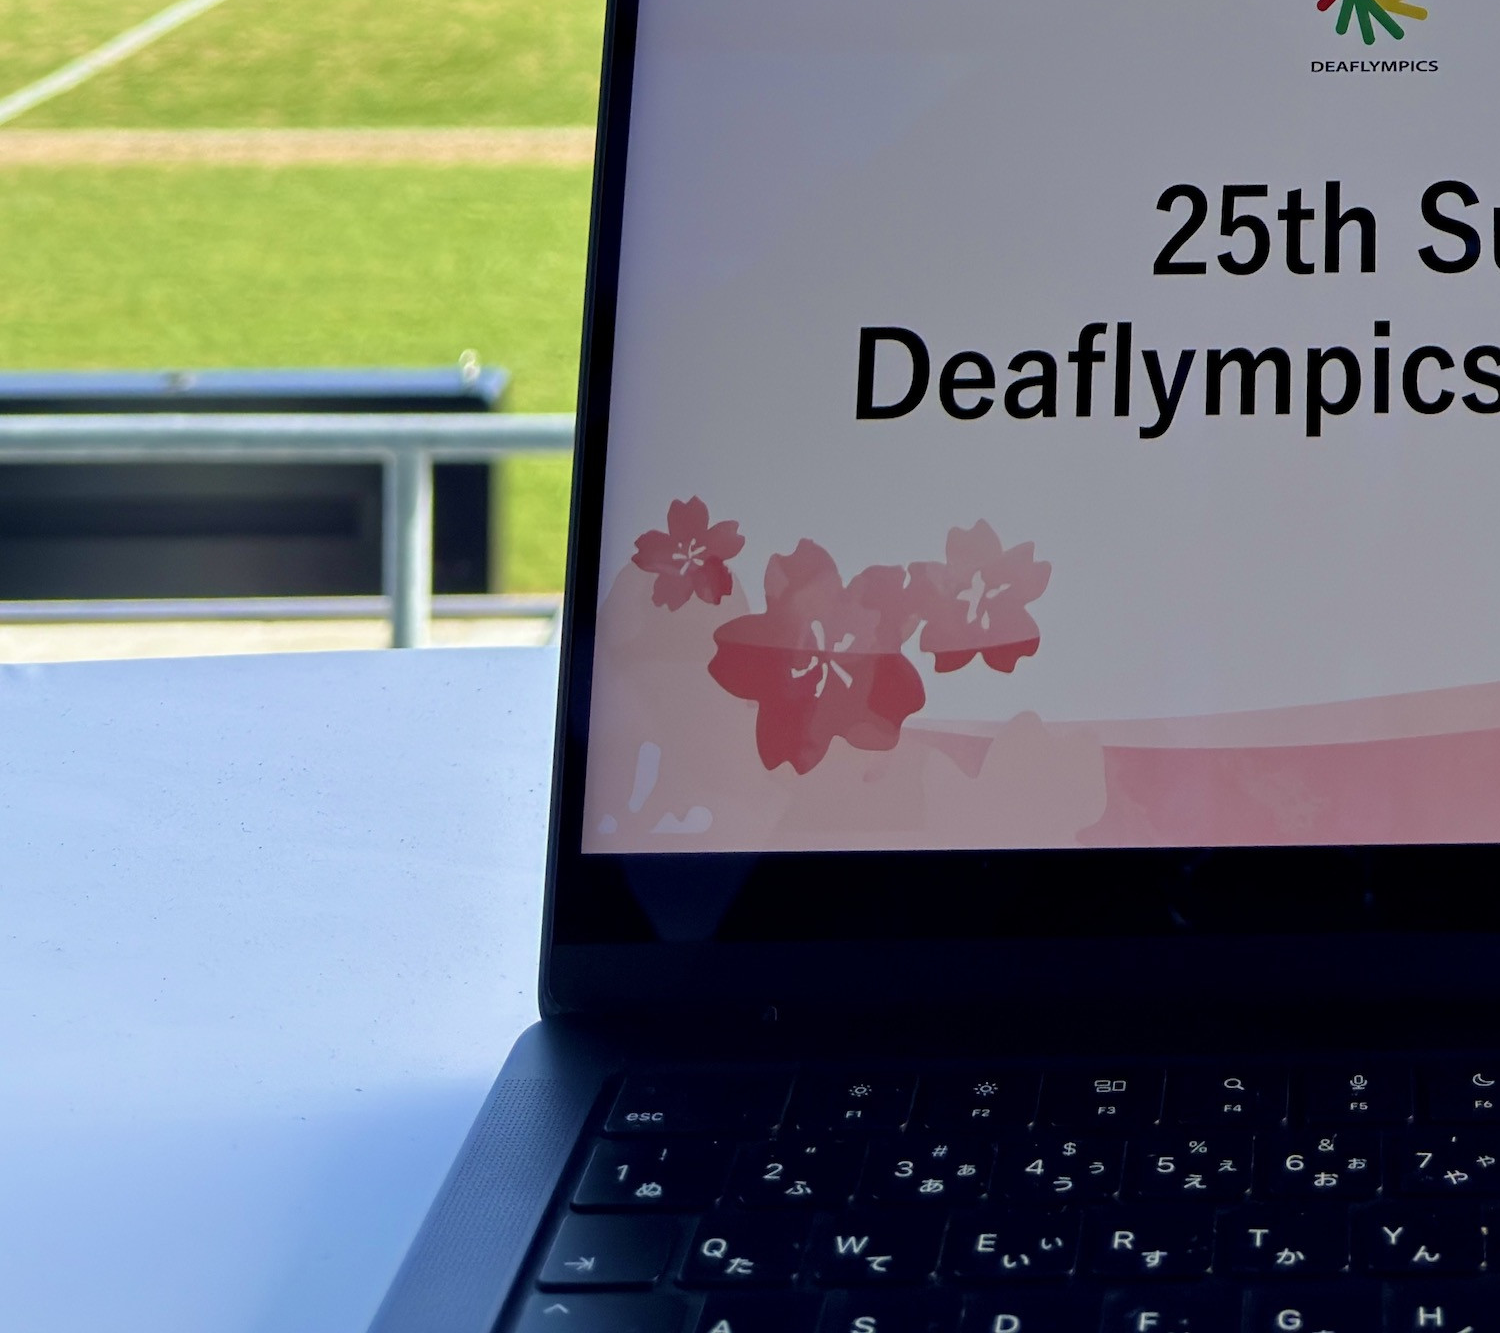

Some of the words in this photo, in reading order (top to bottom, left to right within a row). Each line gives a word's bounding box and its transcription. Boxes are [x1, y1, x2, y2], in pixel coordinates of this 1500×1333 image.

[1310, 59, 1439, 74] DEAFLYMPICS
[1152, 179, 1378, 277] 25th
[970, 1108, 992, 1118] F2
[1096, 1106, 1117, 1115] F3
[1222, 1104, 1243, 1113] F4
[1349, 1101, 1370, 1111] F5
[1473, 1100, 1494, 1109] F6
[624, 1112, 665, 1122] esc
[844, 1110, 863, 1119] F1
[893, 1160, 915, 1178] 3
[1024, 1158, 1046, 1175] 4
[1155, 1156, 1176, 1173] 5
[1284, 1154, 1306, 1171] 6
[1415, 1152, 1434, 1169] 7
[616, 1164, 630, 1181] 1
[761, 1162, 785, 1180] 2
[975, 1233, 998, 1253] E
[1111, 1230, 1136, 1250] R
[1247, 1228, 1270, 1248] T
[1381, 1226, 1404, 1245] Y
[700, 1237, 728, 1259] Q
[835, 1235, 870, 1255] W
[850, 1316, 877, 1333] S
[993, 1314, 1021, 1333] D
[1137, 1311, 1159, 1332] F
[1276, 1309, 1303, 1331] G
[1417, 1306, 1444, 1327] H
[708, 1319, 733, 1333] A
